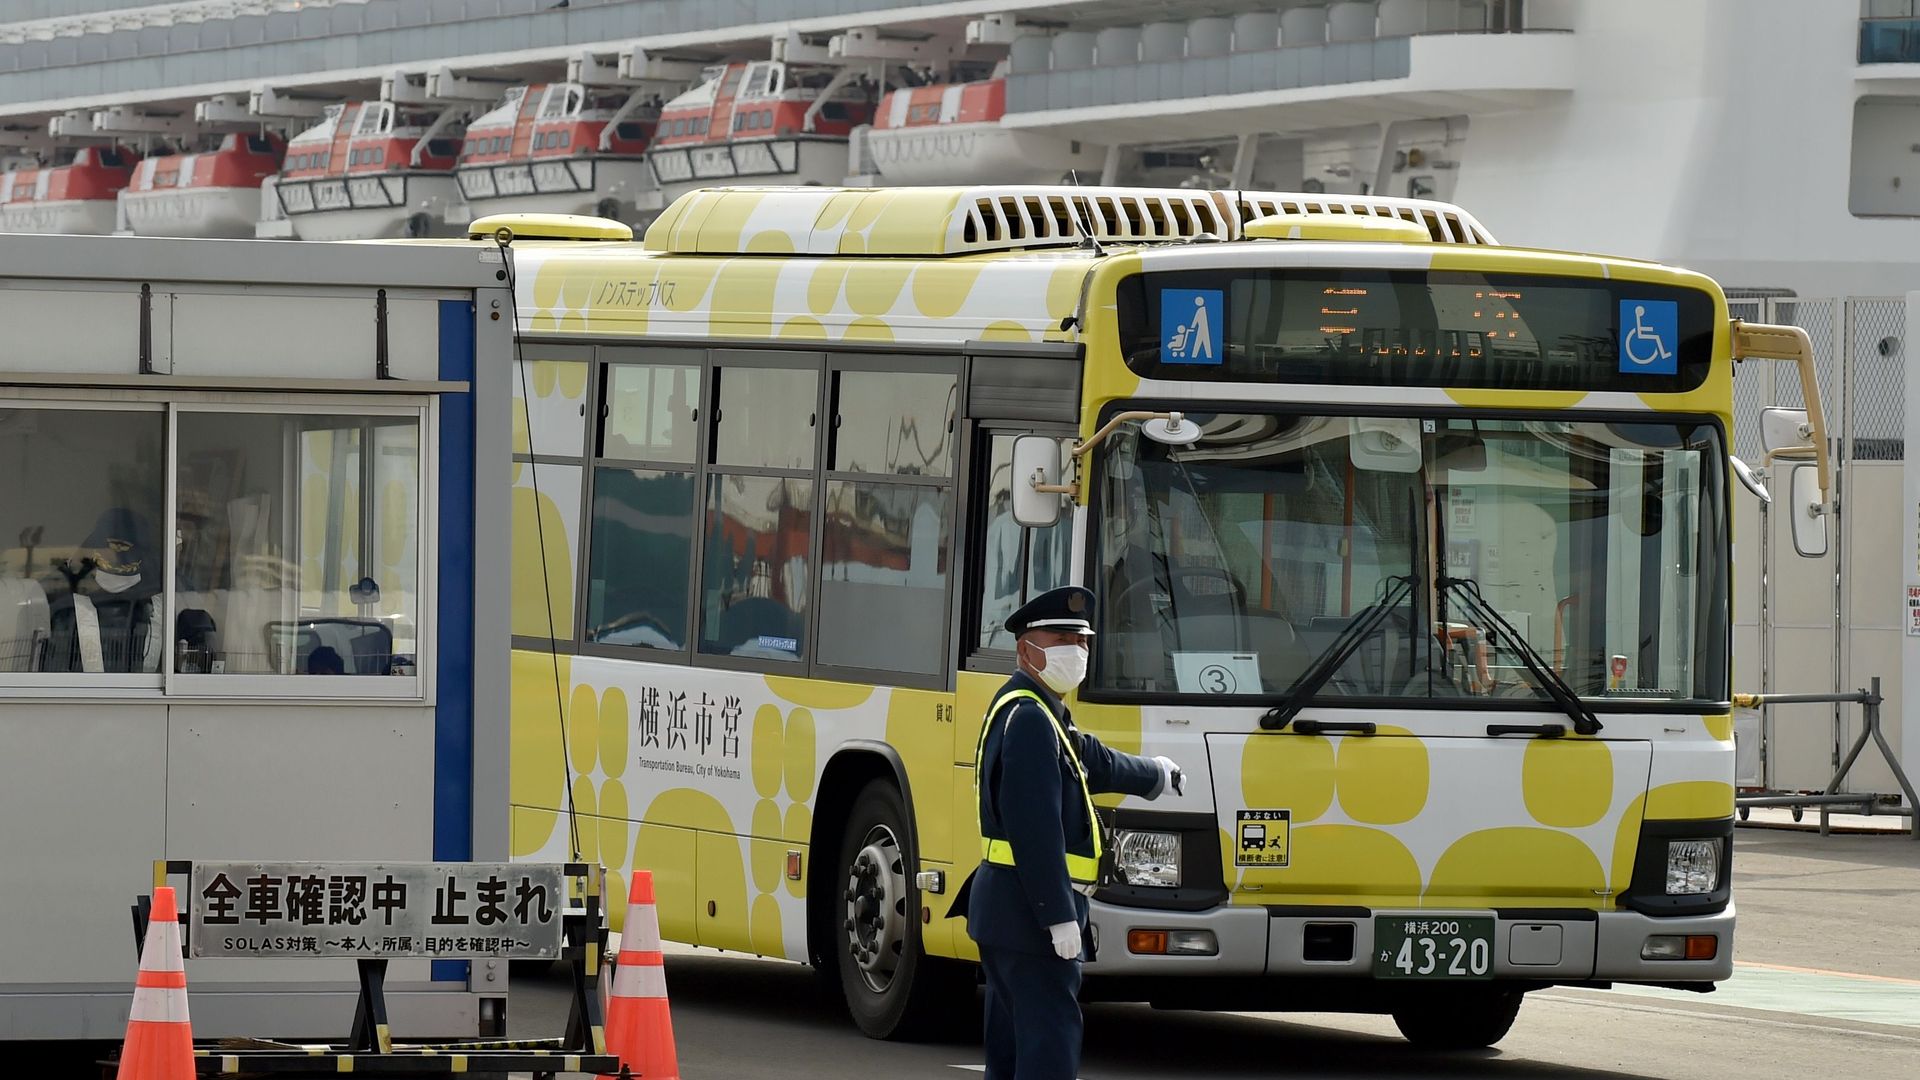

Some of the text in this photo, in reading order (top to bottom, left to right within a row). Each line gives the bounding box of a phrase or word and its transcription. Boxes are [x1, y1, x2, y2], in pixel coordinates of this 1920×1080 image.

[596, 280, 675, 306] ノンステップバス
[638, 686, 743, 759] 横浜市営
[936, 703, 953, 723] 貸切
[639, 757, 740, 779] Transportation Bureau, City of Yokohama
[1243, 811, 1282, 820] あぶない
[202, 873, 553, 926] 全車確認中 止まれ
[224, 936, 318, 951] SOLAS対策
[1395, 937, 1489, 976] 43-20
